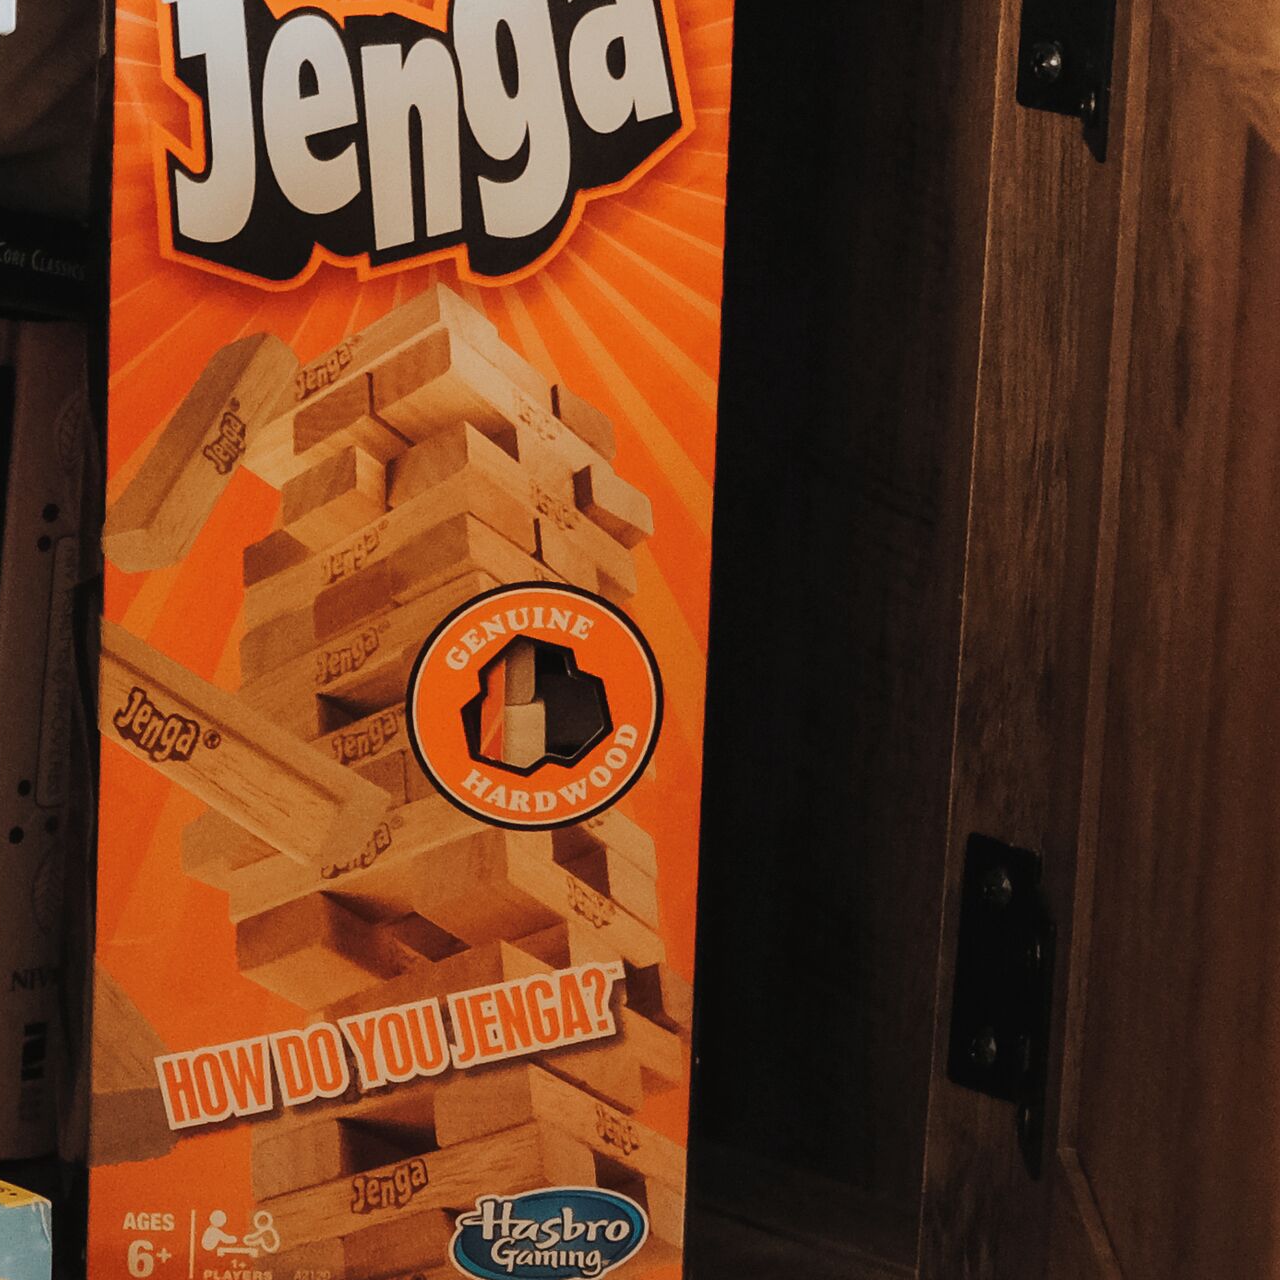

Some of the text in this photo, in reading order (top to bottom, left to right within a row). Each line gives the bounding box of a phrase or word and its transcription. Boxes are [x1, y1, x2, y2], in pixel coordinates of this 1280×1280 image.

[294, 338, 354, 400] Jenga
[443, 605, 596, 672] GENUINE
[113, 685, 201, 763] Jenga
[331, 707, 402, 765] Jenga
[458, 722, 639, 815] HARDWOOD
[161, 967, 614, 1125] HOW DO YOU JENGA?
[351, 1157, 429, 1214] Jenga
[122, 1211, 176, 1232] AGES
[461, 1199, 631, 1245] Hasbro
[127, 1239, 173, 1279] 6+
[202, 1269, 273, 1280] PLAYERS
[490, 1236, 607, 1275] Gaming
